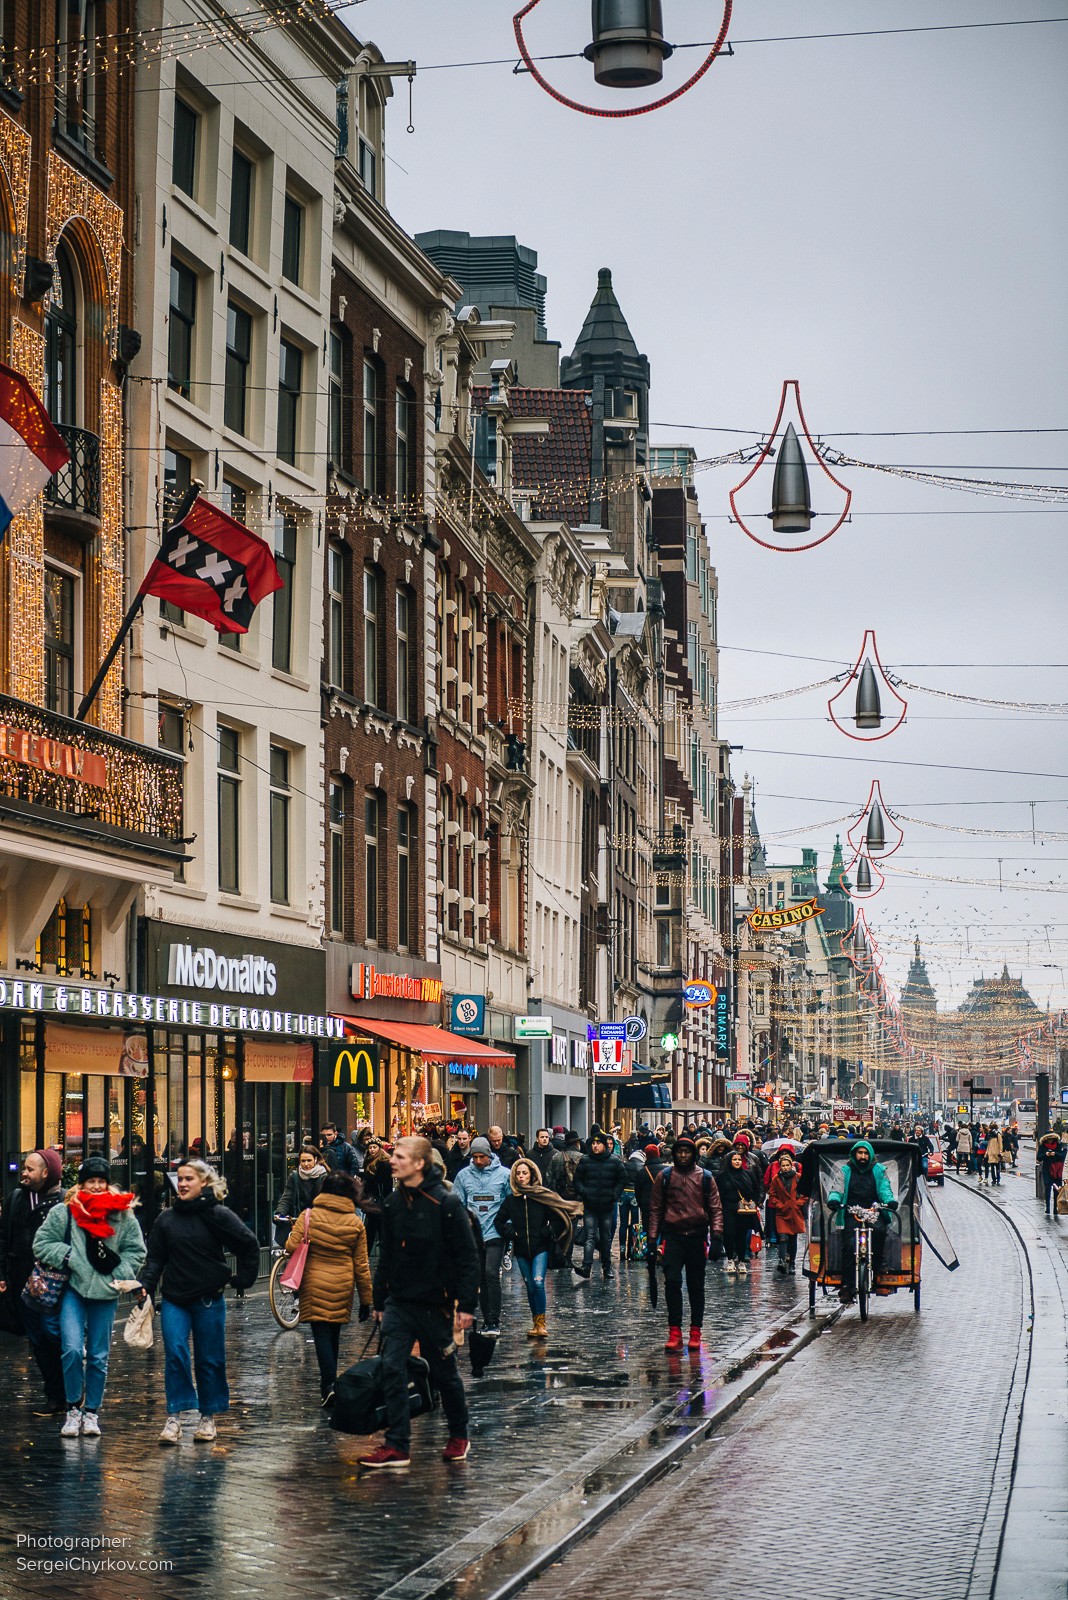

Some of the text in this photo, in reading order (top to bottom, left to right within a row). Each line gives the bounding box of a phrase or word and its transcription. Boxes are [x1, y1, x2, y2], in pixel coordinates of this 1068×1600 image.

[752, 904, 813, 927] CASINO
[171, 943, 277, 996] McDonald's
[686, 987, 710, 1000] C&A
[57, 986, 69, 1012] &
[81, 988, 200, 1025] BRASSERIE
[210, 1003, 231, 1028] DE
[239, 1007, 292, 1034] ROODE
[298, 1014, 345, 1038] LEEUW
[460, 1002, 471, 1013] to
[463, 1008, 475, 1022] go
[717, 994, 727, 1050] PRIMARK
[598, 1063, 618, 1071] KFC
